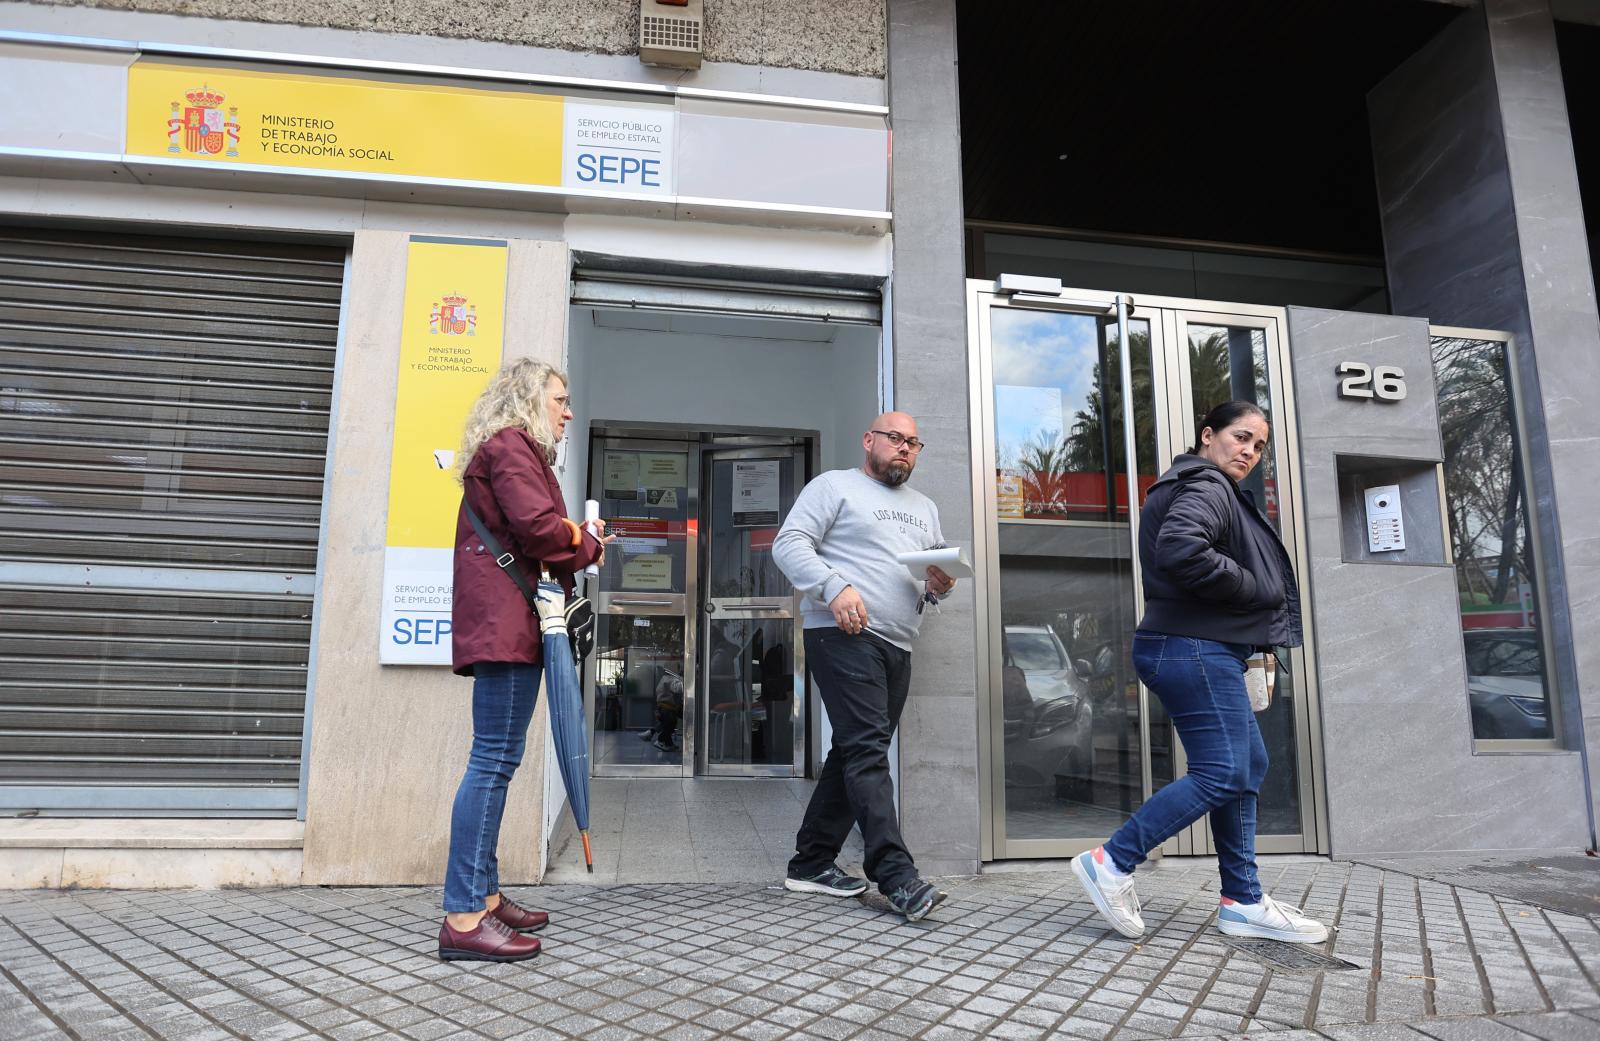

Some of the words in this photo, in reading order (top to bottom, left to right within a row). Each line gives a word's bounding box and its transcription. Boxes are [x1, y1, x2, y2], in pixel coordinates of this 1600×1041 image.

[262, 114, 334, 130] MINISTERIO
[577, 118, 620, 129] SERVICIO
[622, 121, 662, 133] PÚBLICO
[261, 128, 278, 139] DE
[281, 130, 337, 145] TRABAJO
[577, 130, 589, 138] DE
[592, 131, 625, 141] EMPLEO
[628, 134, 661, 144] ESTATAL
[261, 142, 269, 152] Y
[273, 143, 345, 157] ECONOMÍA
[349, 148, 394, 160] SOCIAL
[577, 153, 660, 187] SEPE
[428, 347, 471, 355] MINISTERIO
[417, 363, 460, 372] ECONOMÍA
[440, 356, 472, 365] TRABAJO
[1340, 361, 1407, 400] 26
[872, 509, 891, 521] LOS
[891, 510, 928, 533] ANGELES
[395, 585, 435, 594] SERVICIO
[394, 595, 406, 604] DE
[408, 596, 440, 604] EMPLEO
[393, 618, 453, 645] SEP
